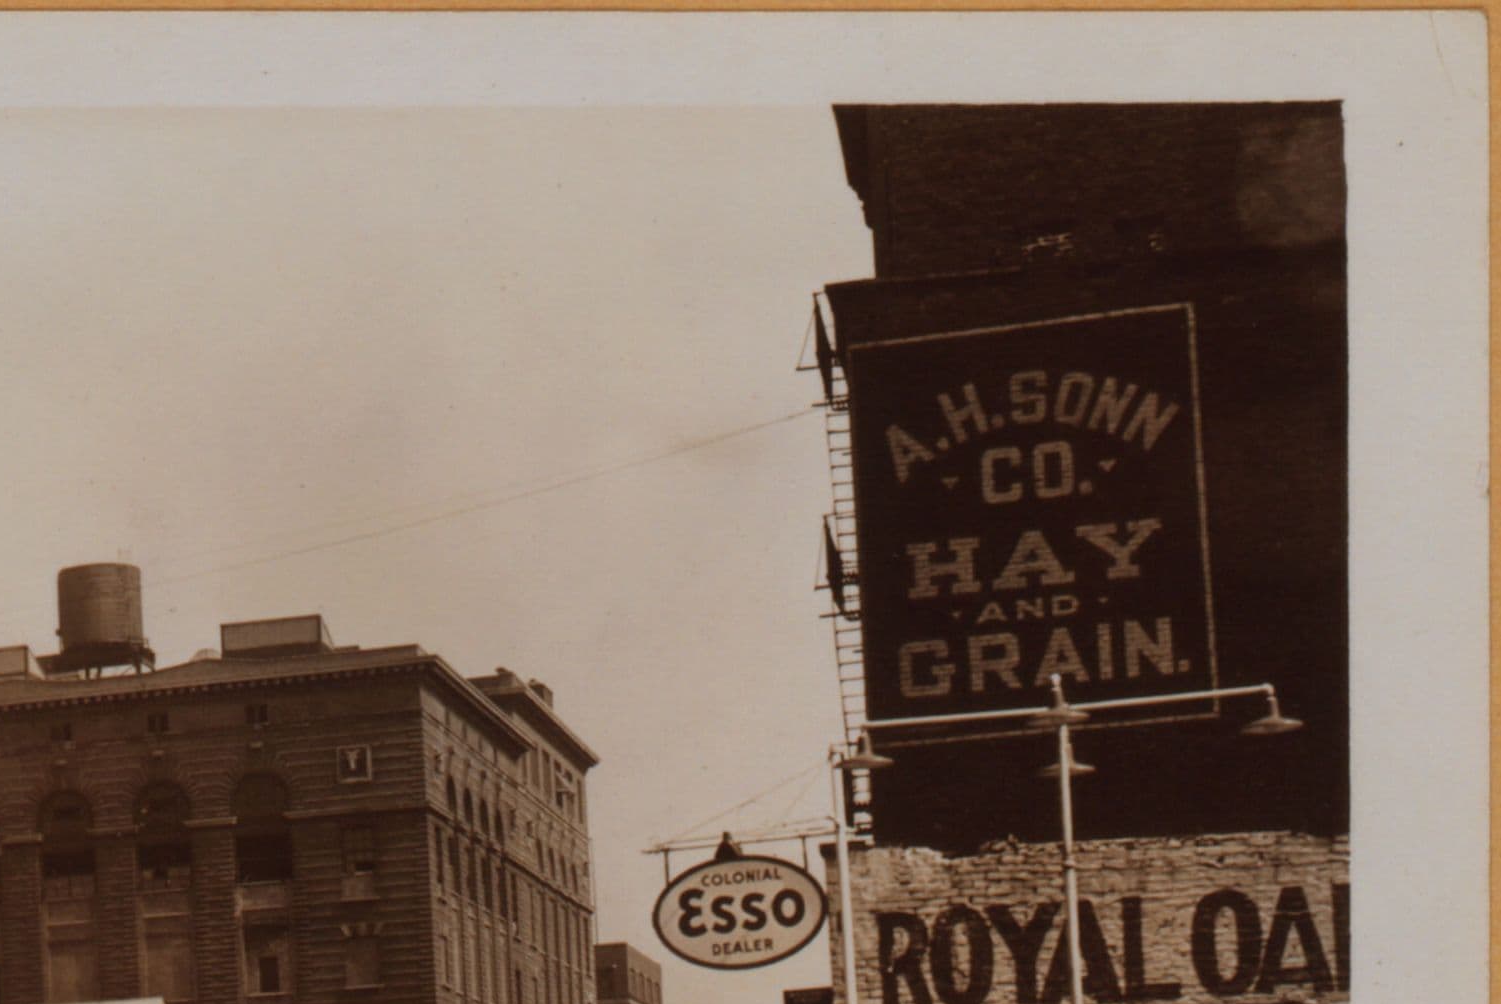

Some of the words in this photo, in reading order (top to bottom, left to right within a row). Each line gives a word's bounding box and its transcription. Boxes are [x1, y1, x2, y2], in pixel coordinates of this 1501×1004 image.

[981, 441, 1093, 503] CO.
[905, 517, 1162, 599] HAY
[976, 595, 1079, 624] AND
[900, 616, 1191, 698] GRAIN.
[701, 868, 782, 888] COLONIAL
[678, 888, 805, 937] ESSO
[712, 938, 774, 956] DEALER
